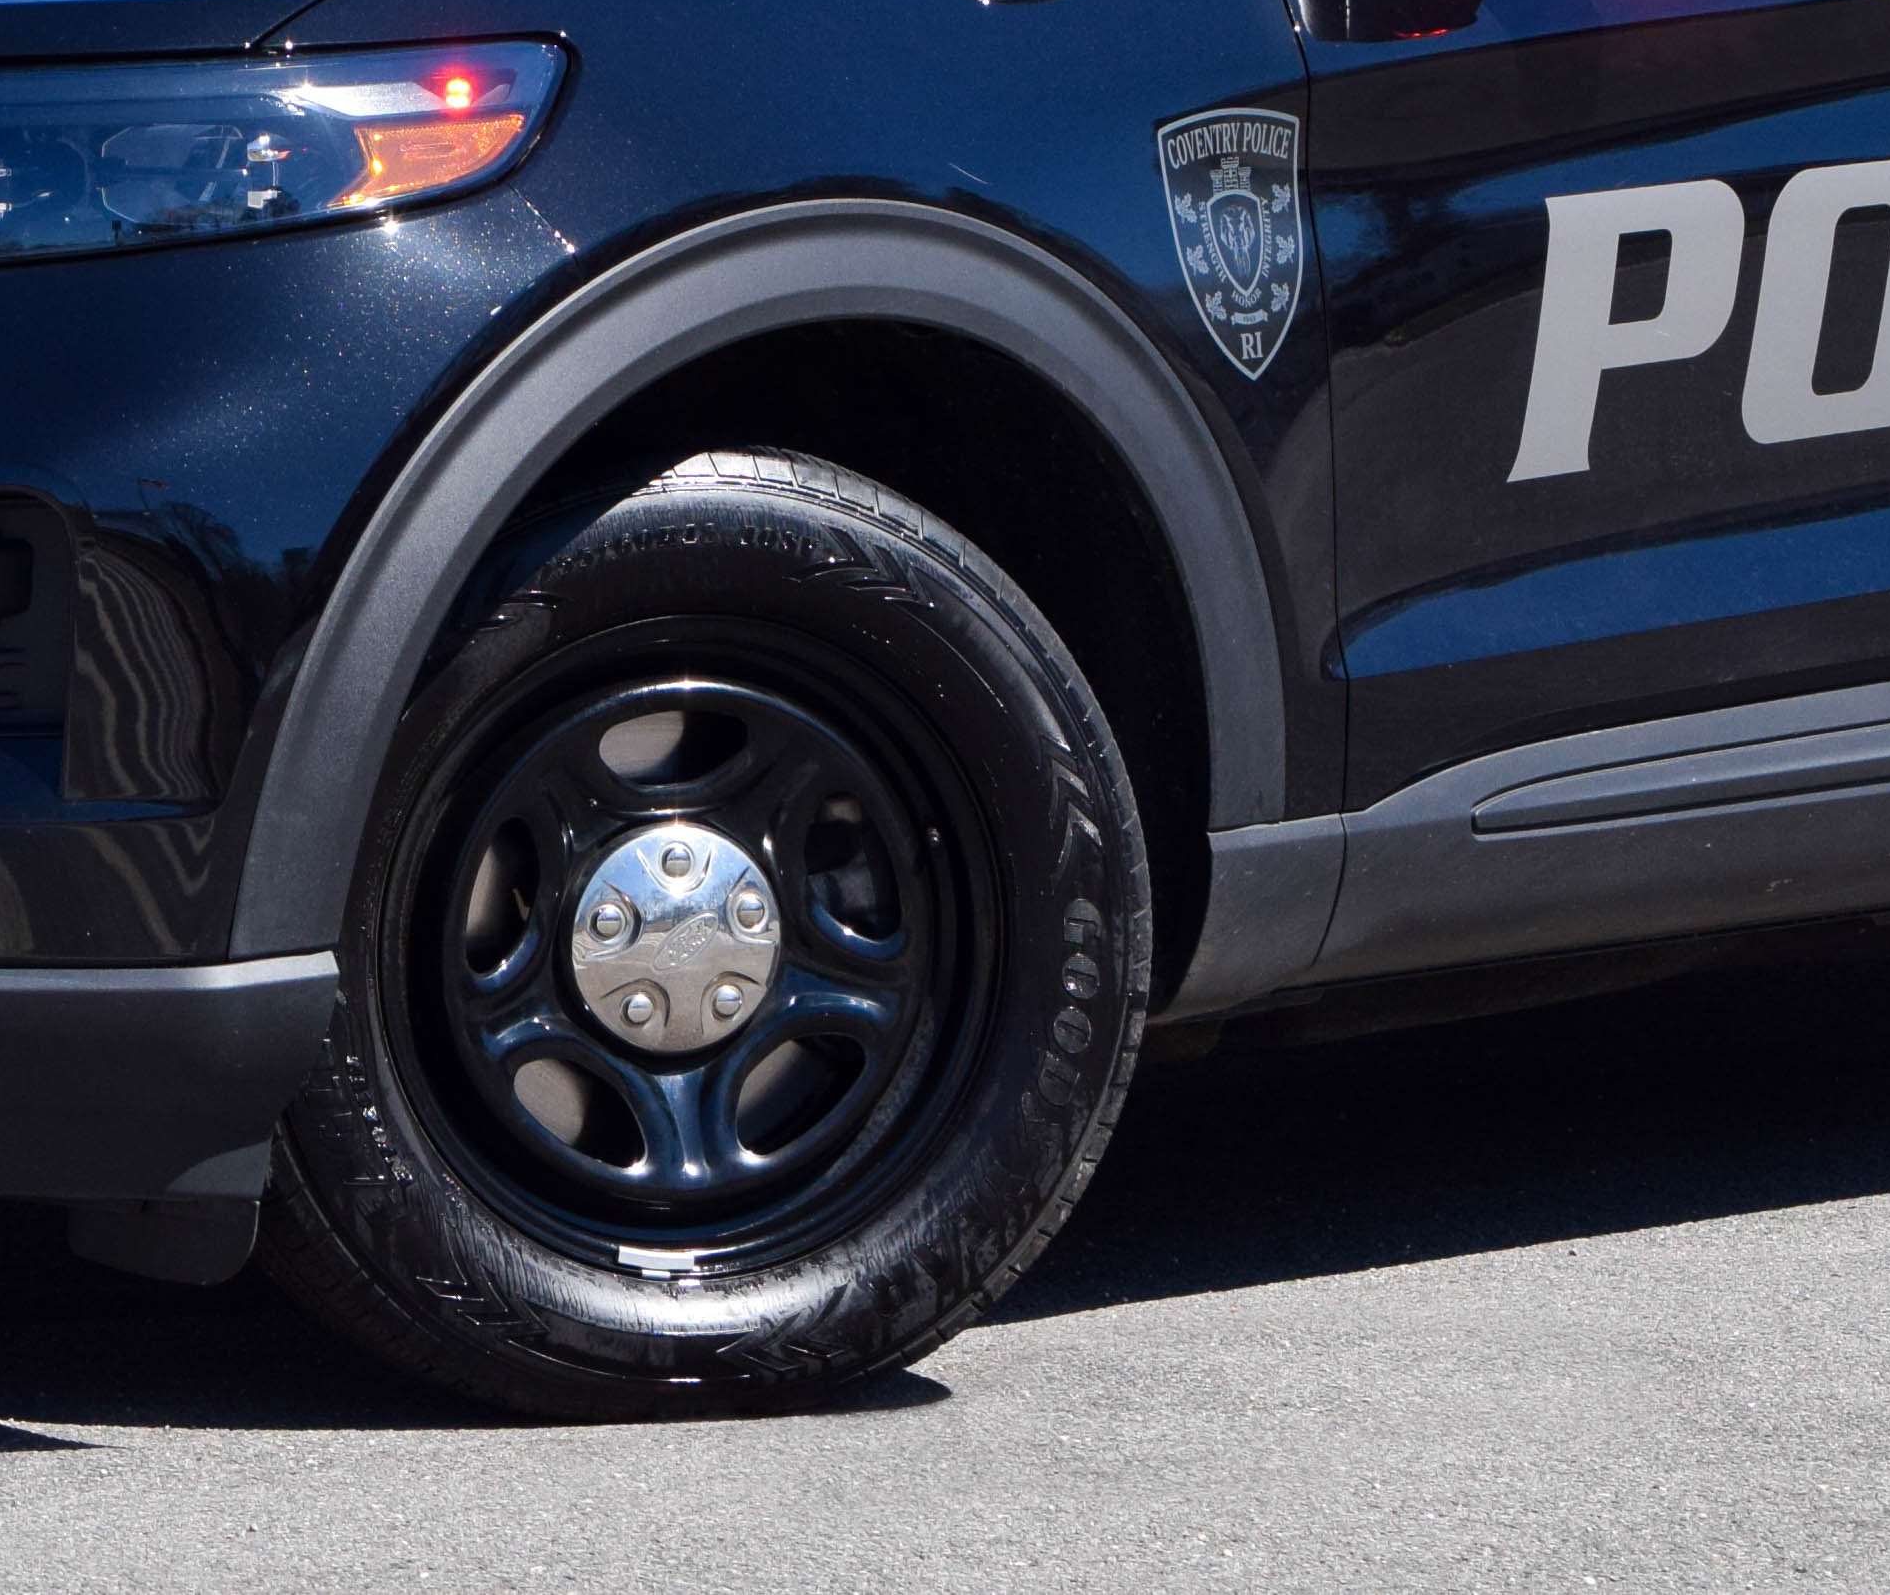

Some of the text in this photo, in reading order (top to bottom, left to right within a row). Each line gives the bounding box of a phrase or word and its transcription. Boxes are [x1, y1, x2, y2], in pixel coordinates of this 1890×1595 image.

[1167, 122, 1292, 170] COVENTRY POLICE
[1198, 201, 1227, 283] STRENGTH
[1260, 196, 1272, 279] INTEGRITY
[1231, 288, 1262, 309] HONOR
[1241, 331, 1264, 360] RI
